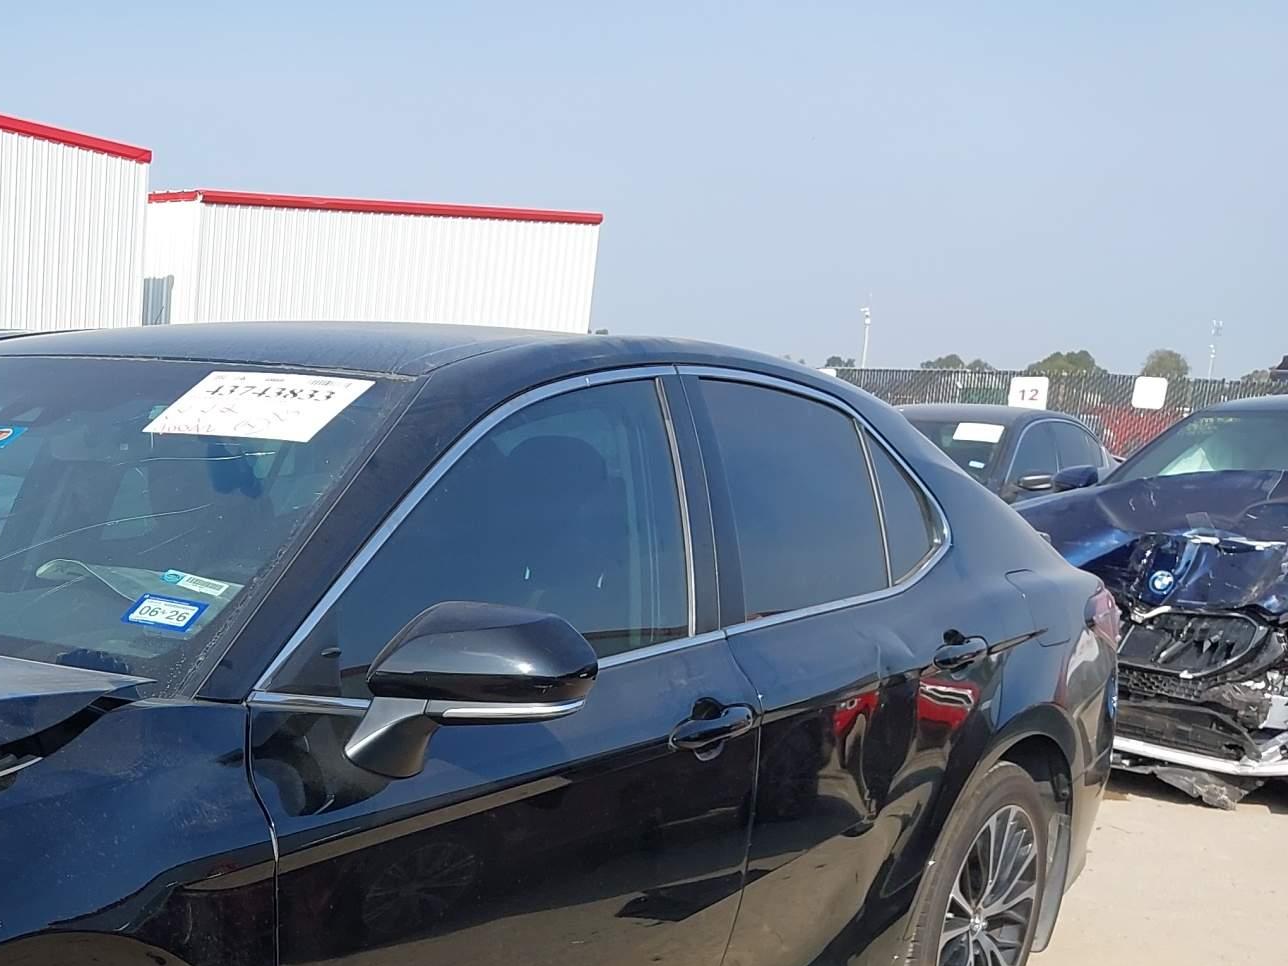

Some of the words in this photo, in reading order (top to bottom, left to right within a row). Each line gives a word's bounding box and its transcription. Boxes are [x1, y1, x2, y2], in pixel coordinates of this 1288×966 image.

[206, 384, 337, 402] 43743833
[1019, 389, 1040, 401] 12
[138, 605, 161, 617] 06
[165, 609, 190, 622] 26
